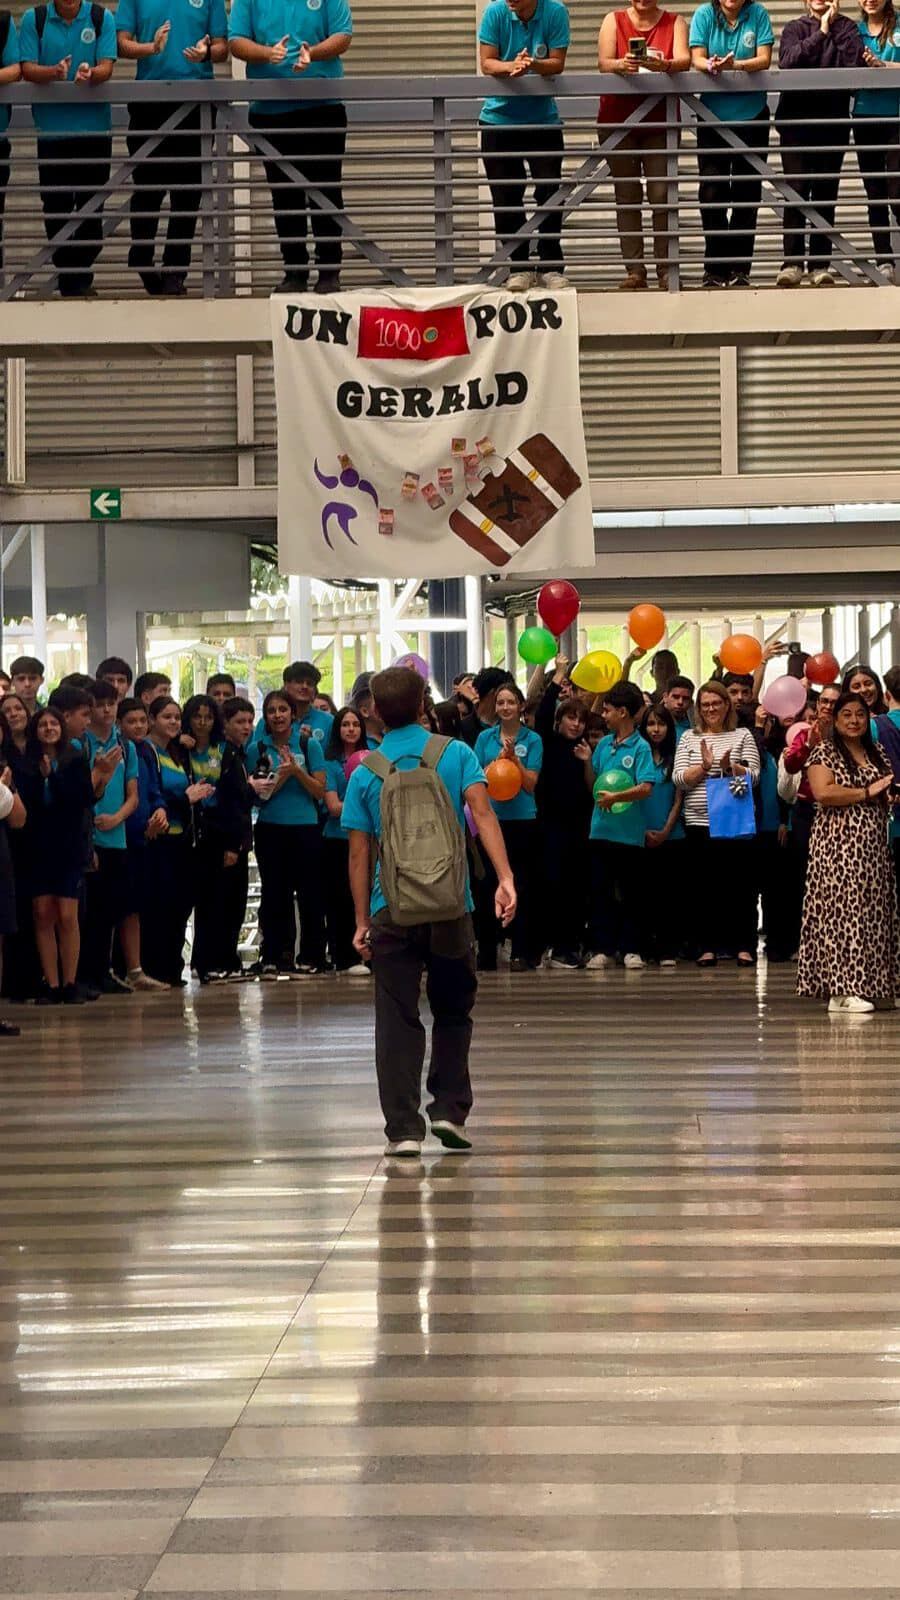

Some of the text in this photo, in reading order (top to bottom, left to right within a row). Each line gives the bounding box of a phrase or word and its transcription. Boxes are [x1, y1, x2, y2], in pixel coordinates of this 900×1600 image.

[284, 298, 562, 351] UN 1000 POR
[336, 371, 529, 418] GERALD
